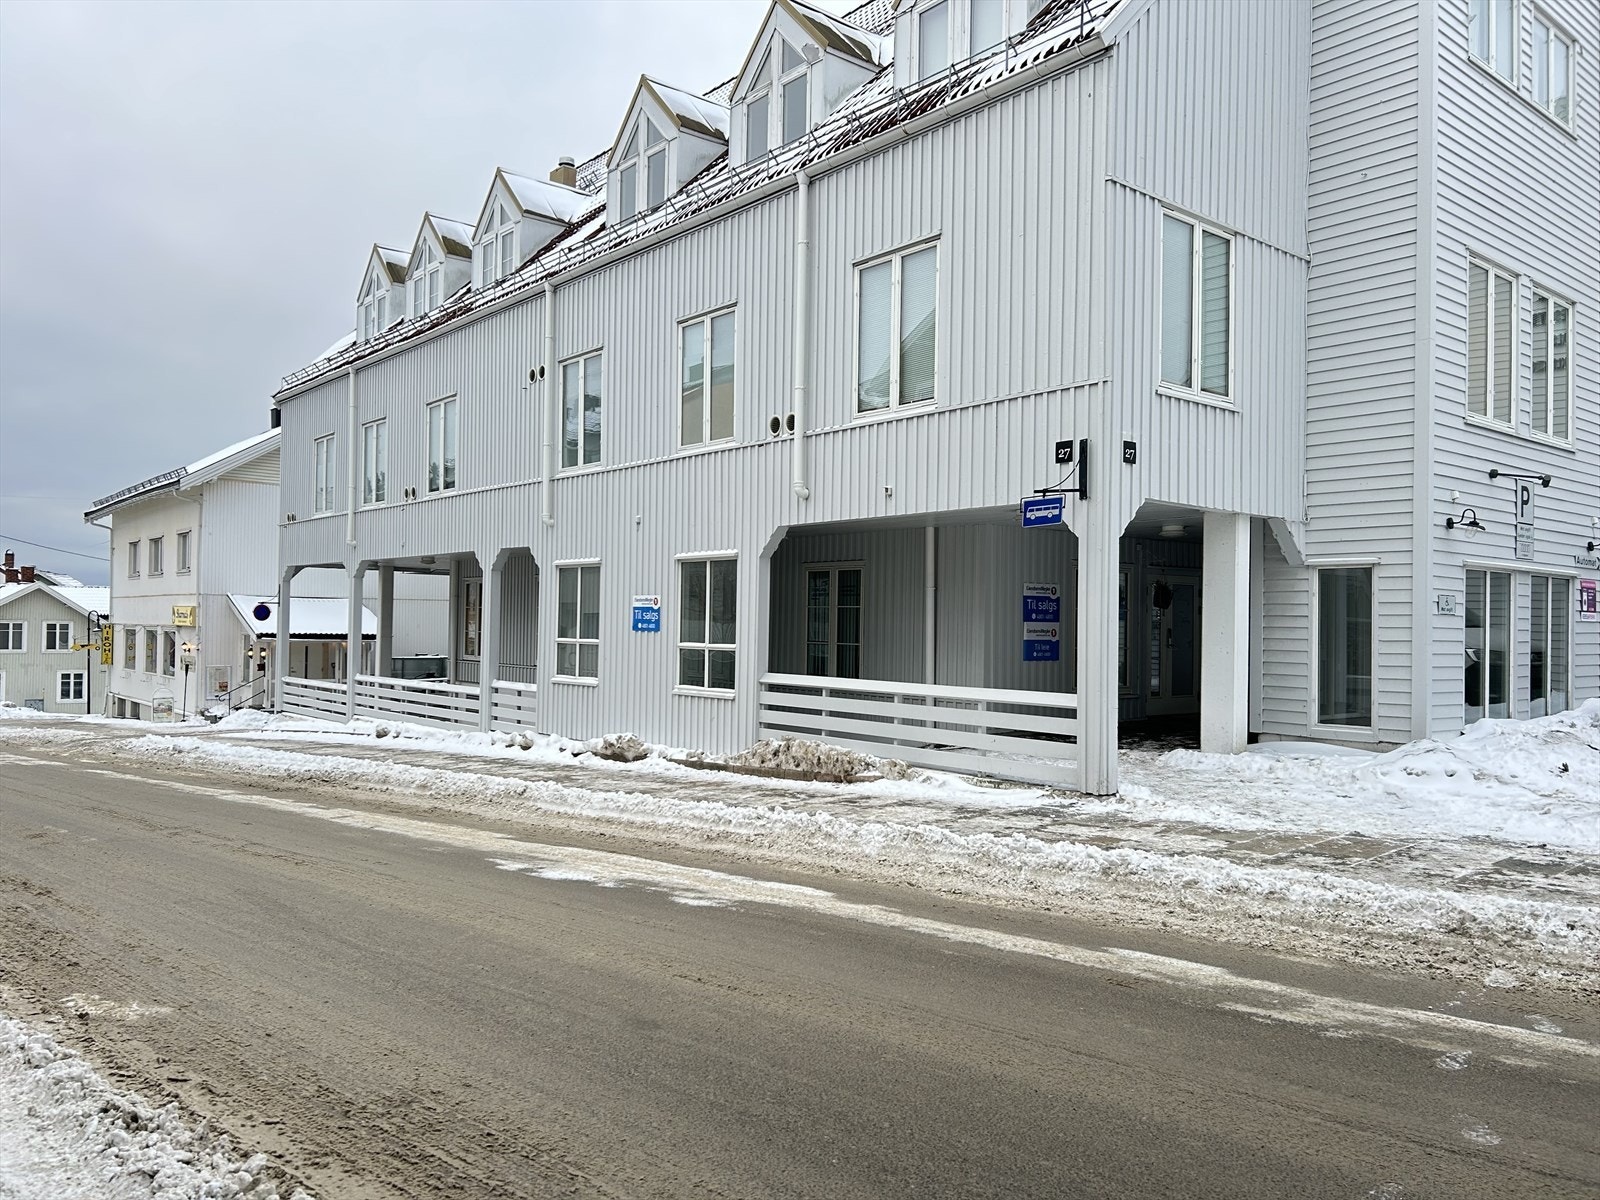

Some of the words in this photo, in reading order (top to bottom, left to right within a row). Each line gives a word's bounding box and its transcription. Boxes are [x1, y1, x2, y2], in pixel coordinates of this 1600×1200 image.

[1058, 448, 1071, 460] 27
[1125, 448, 1135, 461] 27
[1521, 485, 1530, 518] P
[1577, 555, 1597, 568] Automat
[1027, 599, 1037, 610] Til
[1038, 600, 1057, 613] salgs
[643, 610, 659, 622] salgs
